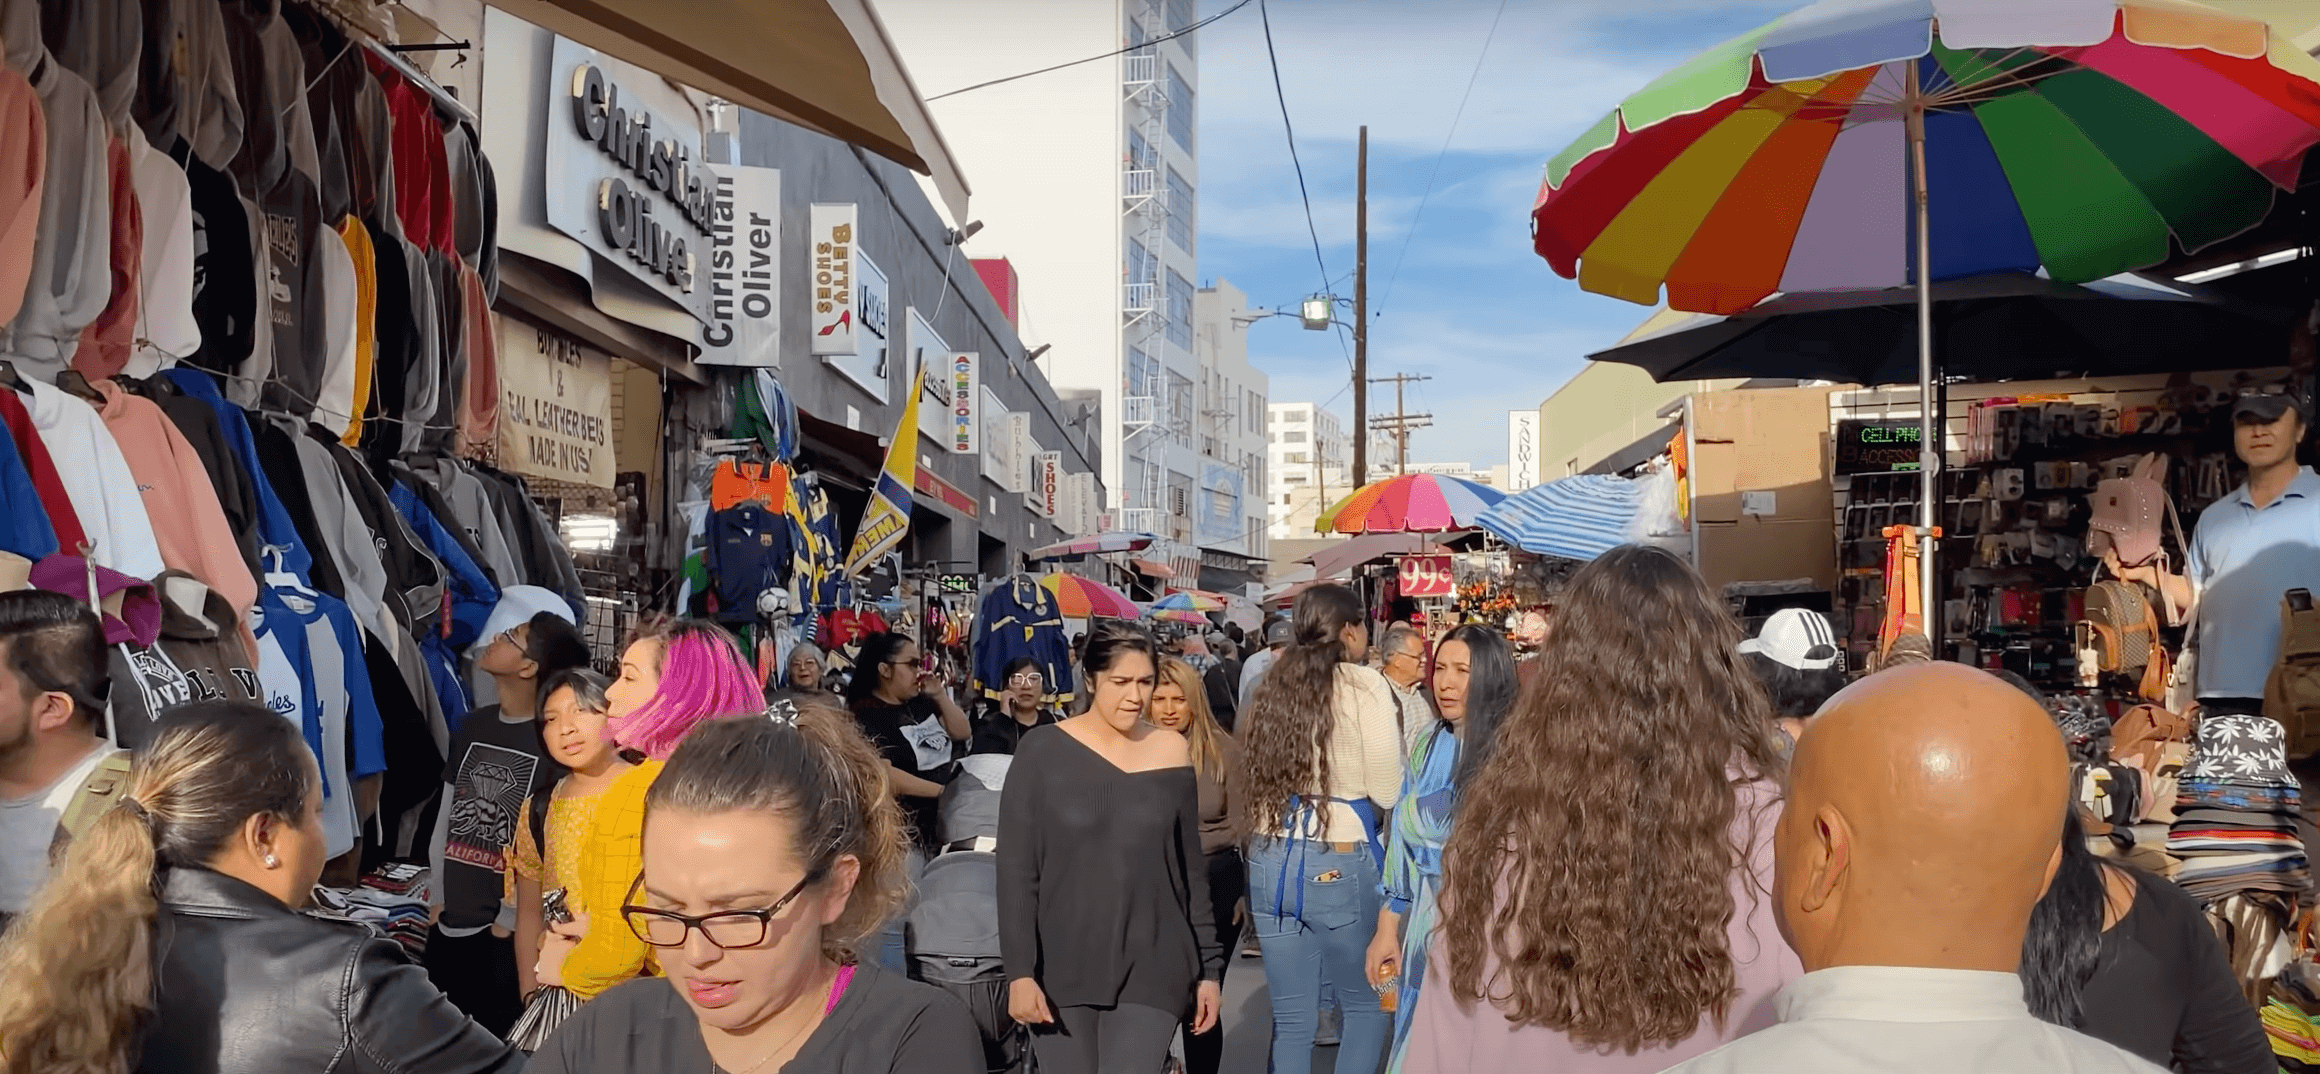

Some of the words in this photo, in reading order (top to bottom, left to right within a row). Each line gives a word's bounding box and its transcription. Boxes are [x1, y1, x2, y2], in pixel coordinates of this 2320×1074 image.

[573, 64, 715, 237] Christian
[742, 212, 772, 318] Oliver
[817, 242, 833, 313] SHOES
[833, 223, 852, 304] BETTY
[1518, 416, 1532, 489] SANDWICH
[1861, 427, 1893, 442] CELL
[1045, 462, 1056, 516] SHOES
